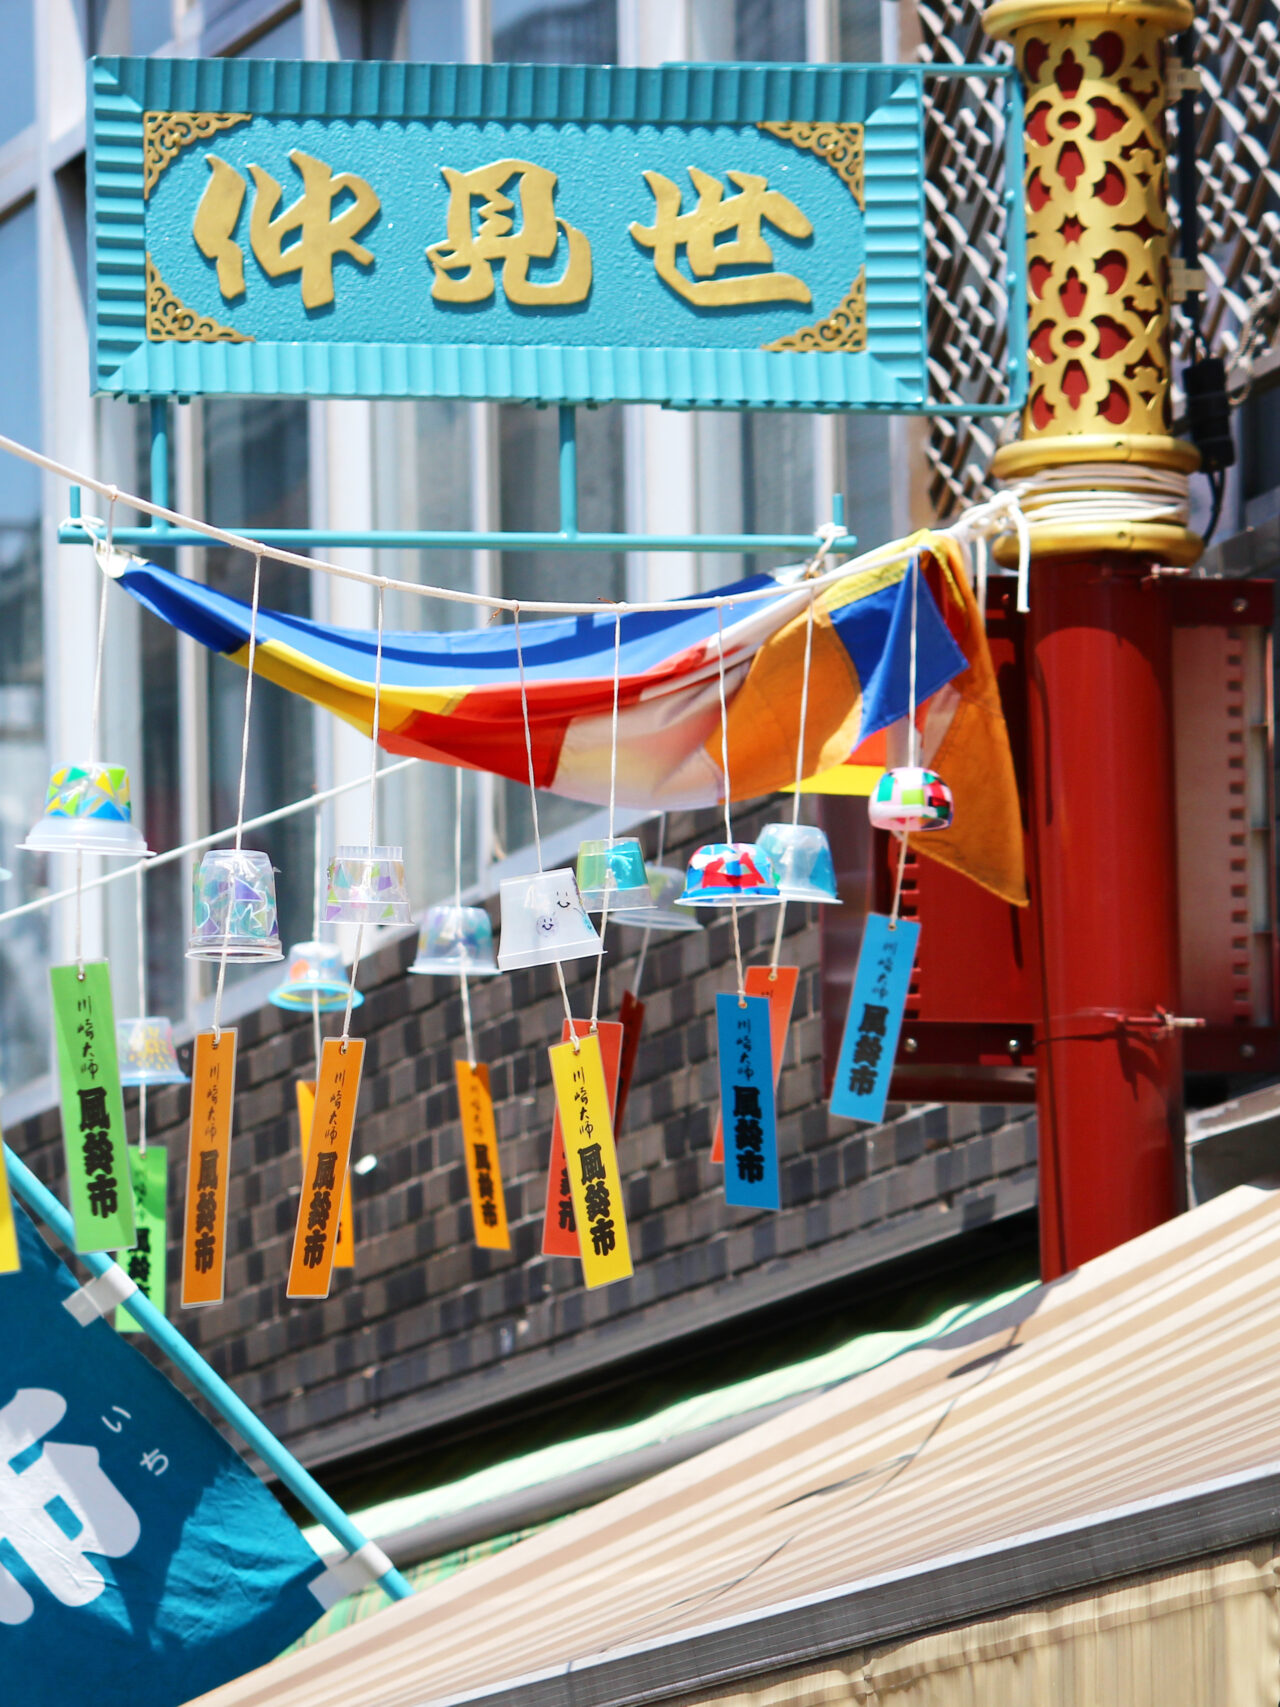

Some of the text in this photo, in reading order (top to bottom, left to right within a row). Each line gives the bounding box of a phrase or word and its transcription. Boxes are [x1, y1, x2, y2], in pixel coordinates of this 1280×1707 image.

[193, 151, 813, 309] 仲見世
[76, 1086, 118, 1219] 風鈴市
[732, 1085, 765, 1184] 風鈴市
[195, 1150, 219, 1274] 風鈴市
[303, 1151, 338, 1269] 風鈴市
[577, 1143, 616, 1257] 風鈴市
[100, 1405, 169, 1475] いち
